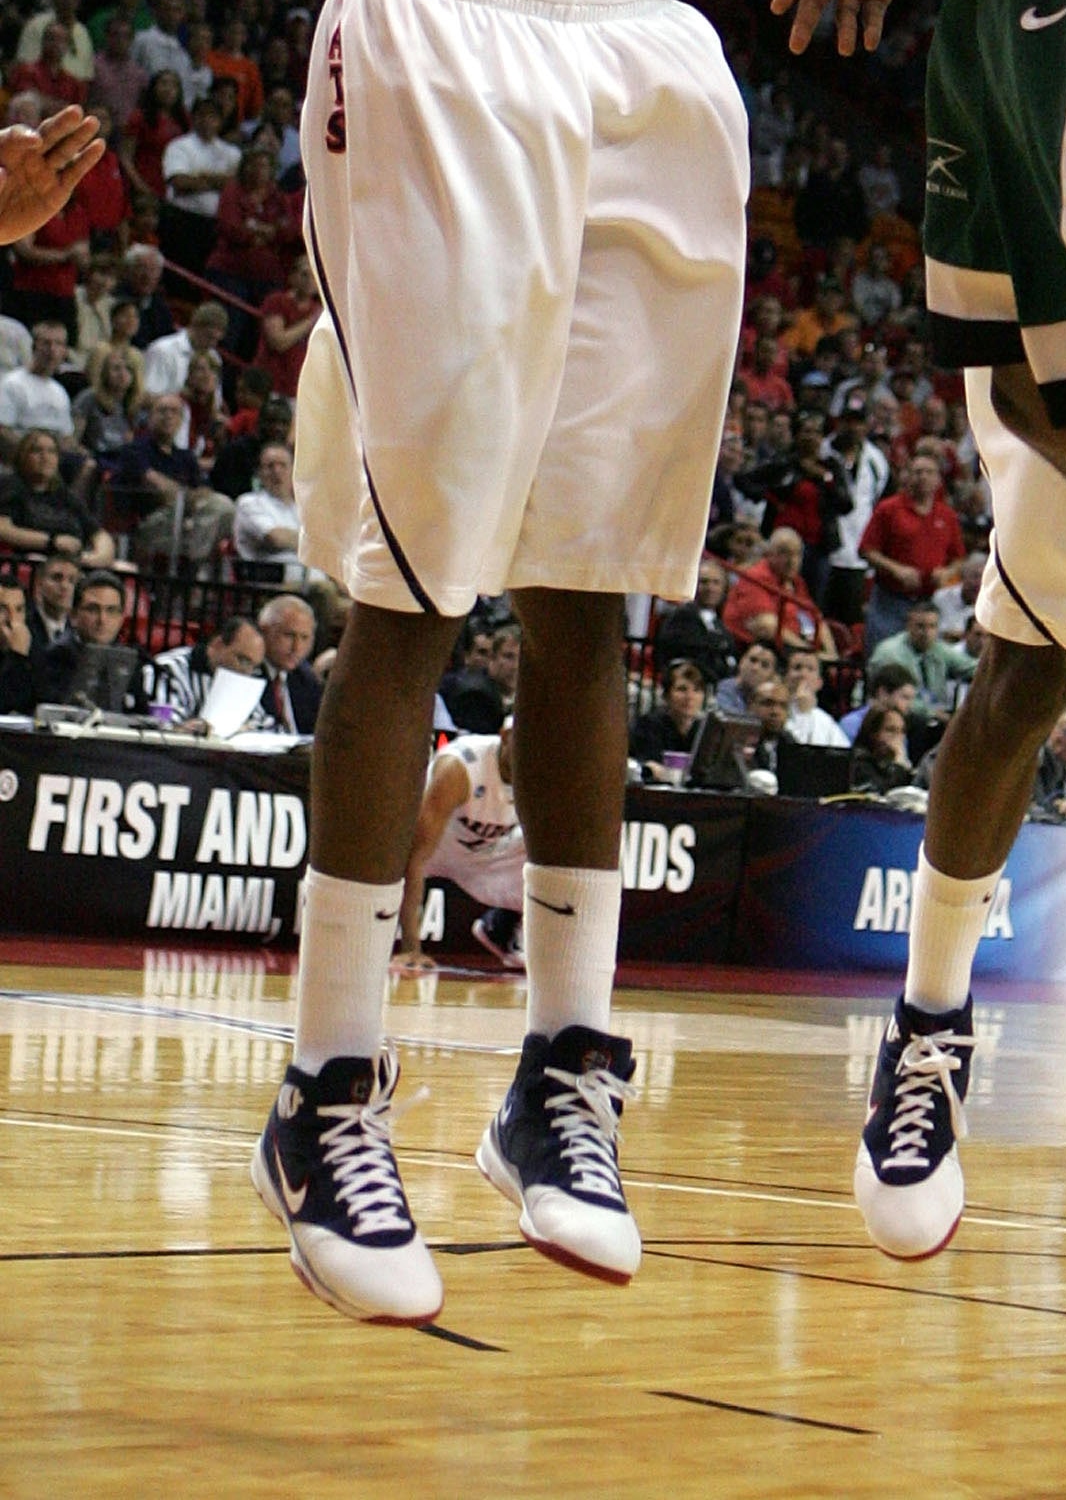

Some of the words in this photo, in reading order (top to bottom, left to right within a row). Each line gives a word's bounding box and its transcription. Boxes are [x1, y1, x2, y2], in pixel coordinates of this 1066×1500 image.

[28, 774, 192, 860] FIRST
[196, 788, 308, 869] AND
[855, 866, 1015, 940] ARA
